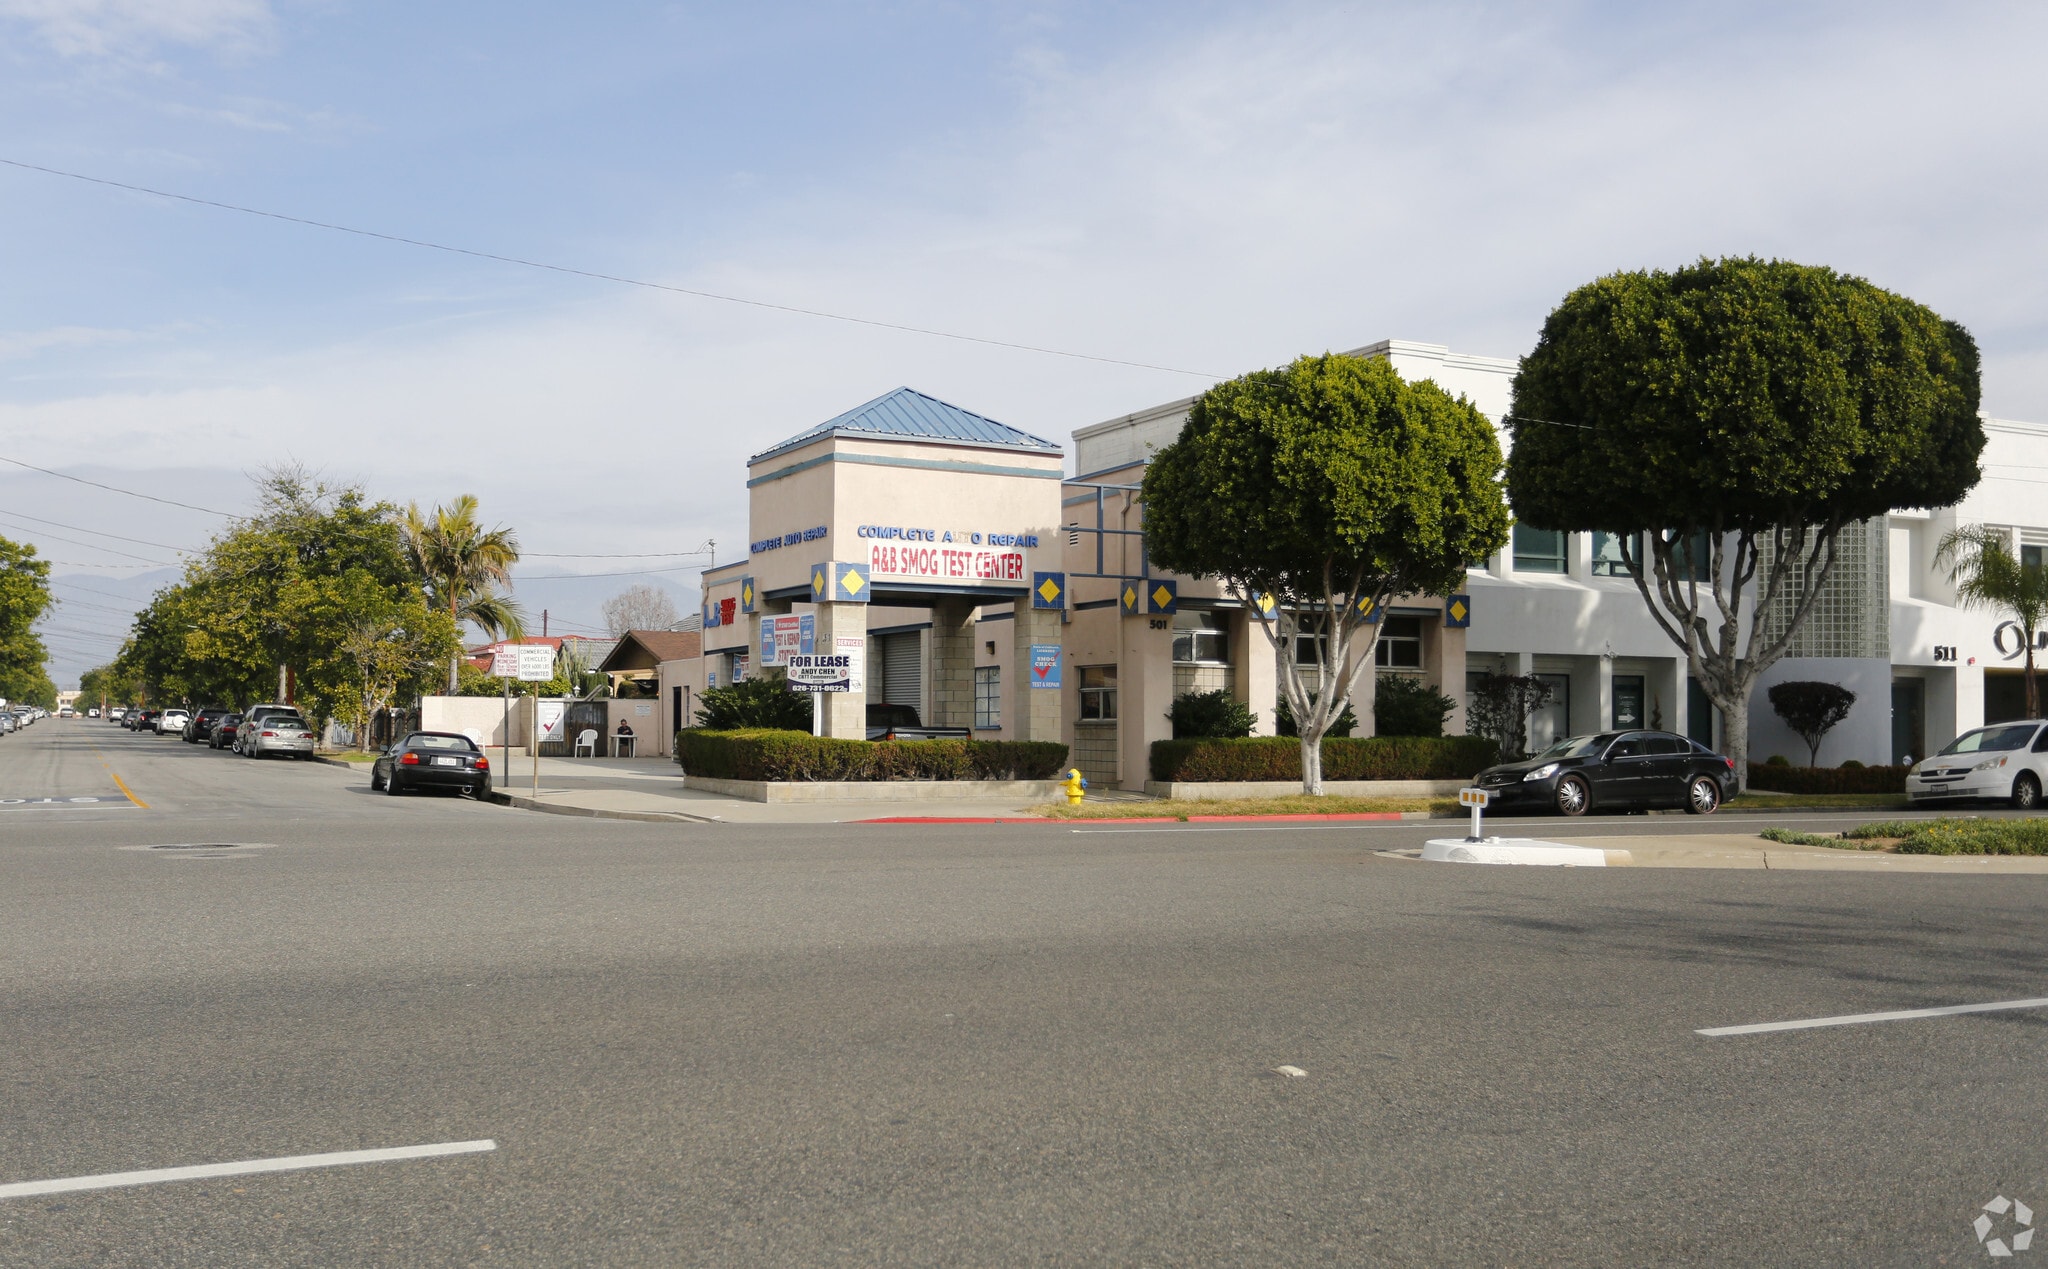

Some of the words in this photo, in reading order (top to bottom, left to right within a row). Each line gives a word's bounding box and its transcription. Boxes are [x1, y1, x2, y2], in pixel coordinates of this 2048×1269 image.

[750, 537, 782, 554] COMPLETE
[783, 532, 802, 547] AUTO
[802, 525, 828, 542] REPAIR
[858, 525, 935, 542] COMPLETE
[988, 533, 1039, 548] REPAIR
[871, 545, 898, 573] A&B
[900, 547, 938, 576] SMOG
[942, 549, 972, 577] TEST
[975, 552, 1023, 579] CENTER
[1149, 619, 1167, 630] 501
[789, 656, 812, 667] FOR
[814, 656, 849, 667] LEASE
[1933, 645, 1957, 661] 511
